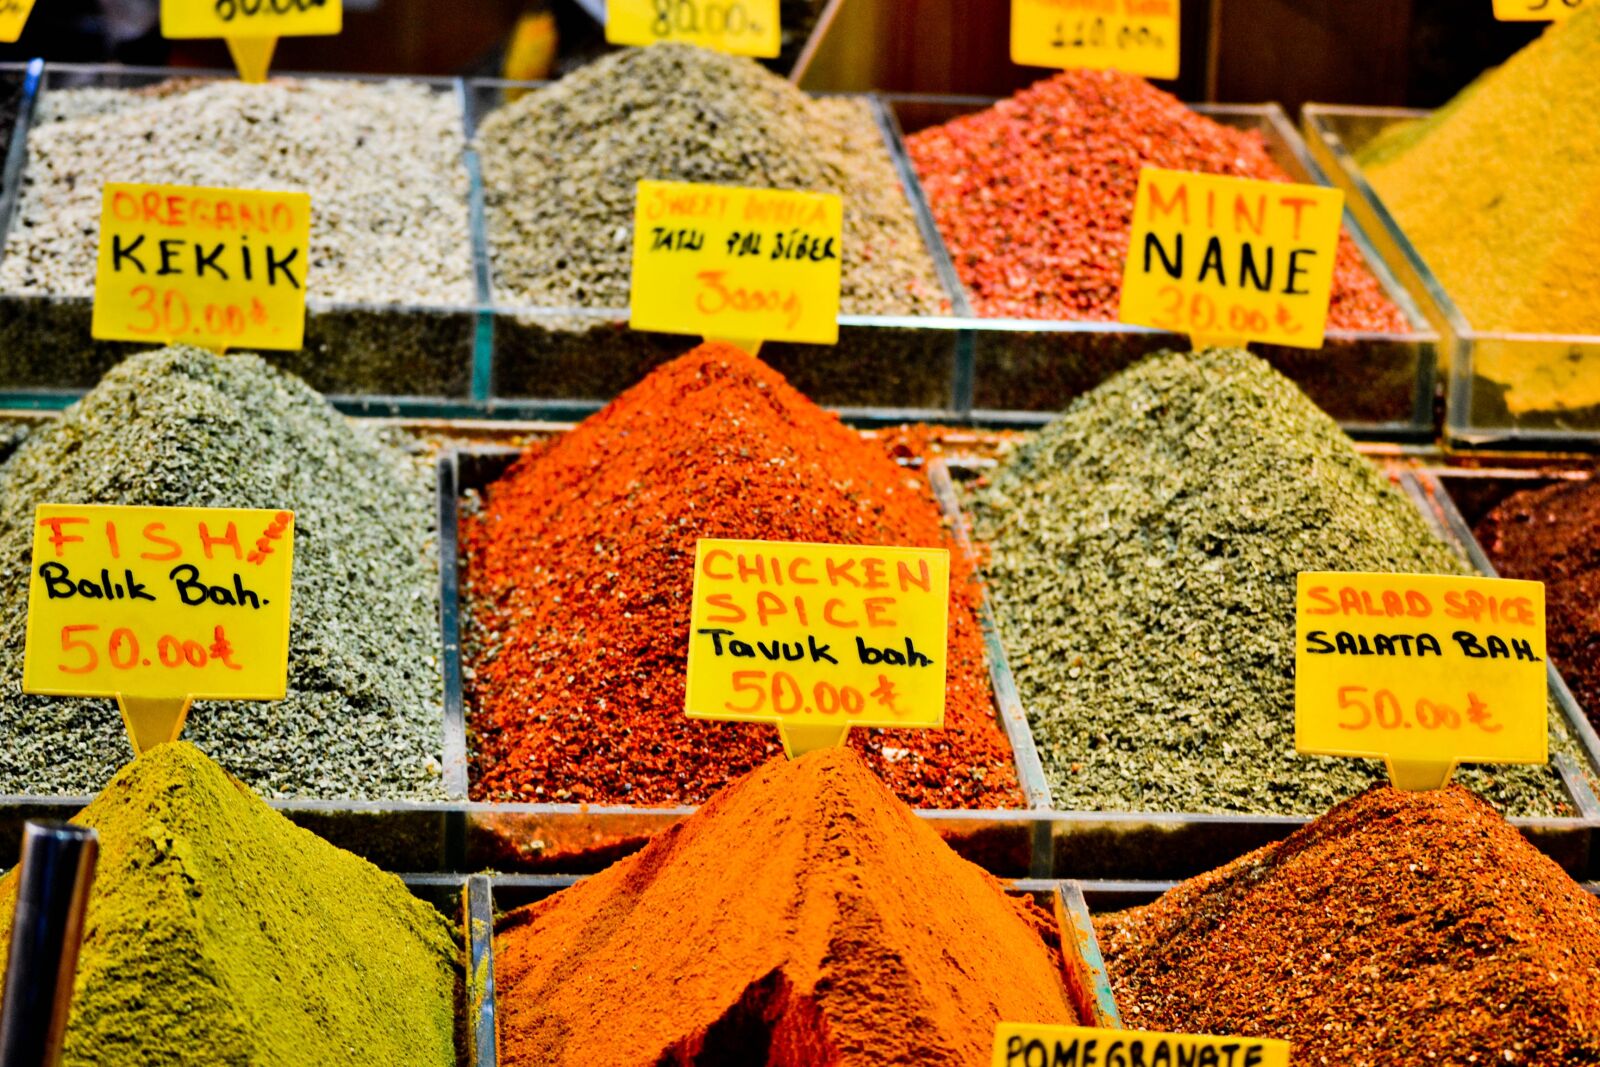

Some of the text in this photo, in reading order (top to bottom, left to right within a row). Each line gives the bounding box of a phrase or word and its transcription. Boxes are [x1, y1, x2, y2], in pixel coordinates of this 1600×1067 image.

[111, 190, 294, 234] OREGANO
[1147, 182, 1318, 241] MINT
[1143, 232, 1317, 295] NANE
[169, 563, 270, 609] Bah.
[702, 549, 931, 593] CHICKEN
[705, 591, 897, 628] SPICE
[1305, 586, 1536, 627] SALAD SPICE
[697, 628, 839, 665] Tavuk
[1305, 630, 1443, 657] SALATA
[1006, 1035, 1264, 1067] POMEGRANATE
